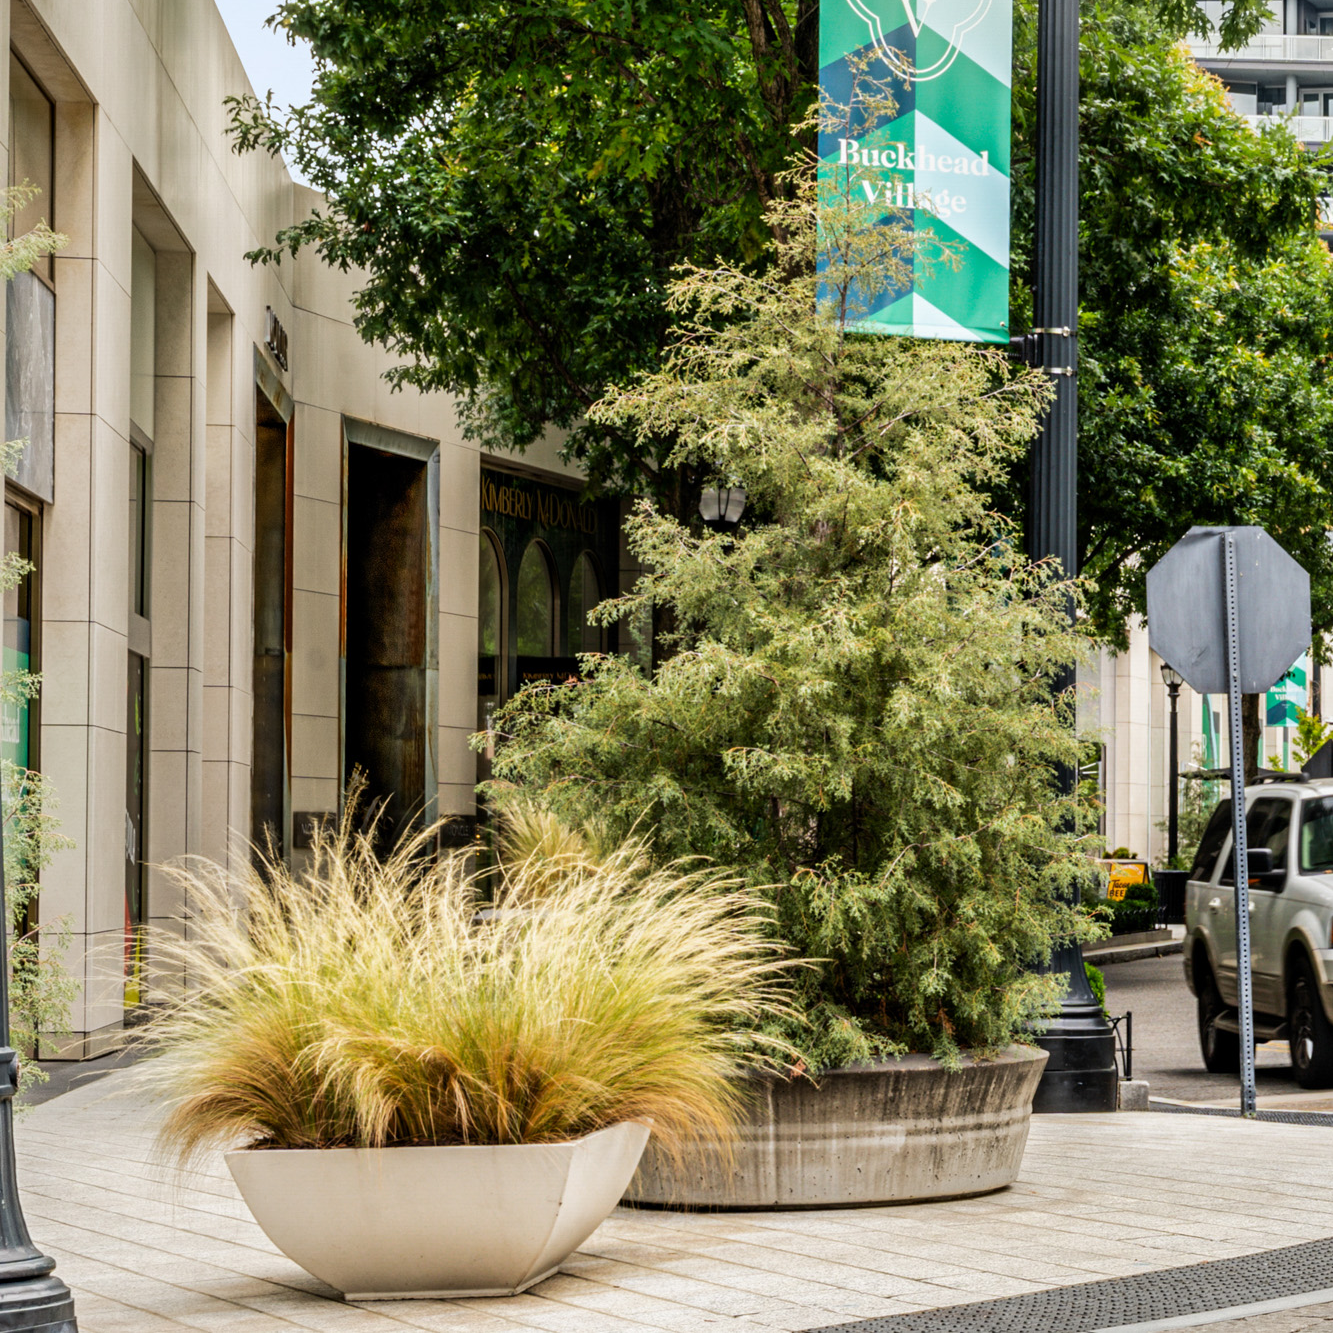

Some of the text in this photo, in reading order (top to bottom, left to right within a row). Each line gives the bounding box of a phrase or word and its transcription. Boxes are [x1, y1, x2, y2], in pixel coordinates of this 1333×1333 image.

[837, 138, 990, 177] Buckhead
[861, 179, 967, 218] Village
[481, 475, 534, 520] KIMBERLY
[1109, 889, 1125, 898] BEE
